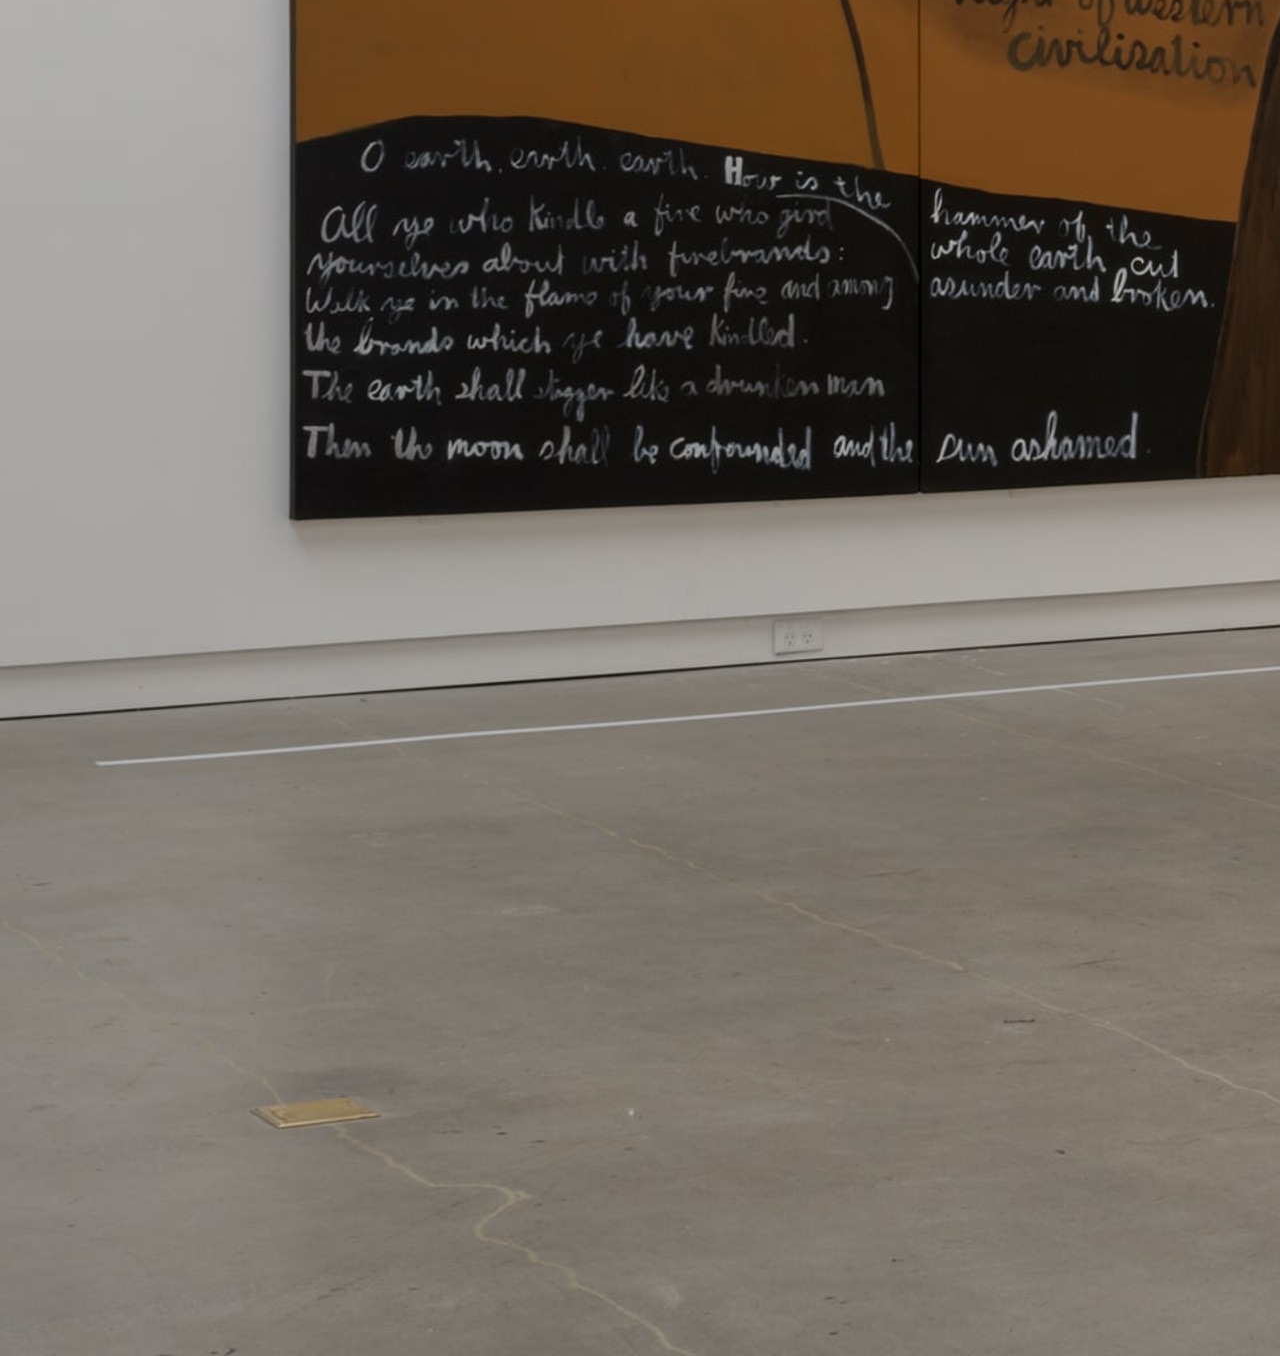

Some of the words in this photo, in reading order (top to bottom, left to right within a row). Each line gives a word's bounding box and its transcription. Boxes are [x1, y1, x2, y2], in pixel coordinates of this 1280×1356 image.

[360, 141, 384, 173] O
[795, 171, 818, 190] is
[835, 176, 891, 208] the
[392, 215, 434, 248] ye
[449, 197, 513, 234] who
[623, 210, 638, 227] a
[654, 193, 701, 235] fire
[716, 202, 769, 225] who
[930, 187, 1045, 231] hammer
[1058, 210, 1086, 243] of
[1106, 214, 1162, 250] the
[306, 251, 470, 285] yourselves
[482, 242, 563, 275] about
[582, 240, 647, 273] with
[930, 230, 1008, 265] whole
[1029, 236, 1106, 273] earth
[1130, 250, 1179, 278] cut
[379, 292, 416, 323] ye
[428, 290, 459, 310] in
[471, 286, 509, 311] the
[524, 279, 598, 318] flame
[608, 287, 632, 316] of
[641, 284, 713, 314] your
[724, 272, 767, 313] fire
[781, 274, 820, 301] and
[831, 275, 893, 310] among
[930, 270, 1041, 300] asunder
[1054, 276, 1099, 302] and
[303, 322, 341, 353] the
[354, 317, 453, 357] brands
[467, 323, 551, 354] which
[563, 330, 604, 362] ye
[618, 317, 694, 352] have
[303, 370, 352, 404] The
[367, 370, 442, 406] earth
[455, 367, 526, 401] shall
[623, 365, 670, 403] like
[682, 379, 699, 396] a
[707, 363, 820, 398] drunken
[827, 373, 885, 397] man
[303, 423, 372, 459] Then
[390, 425, 433, 461] the
[447, 438, 524, 461] moon
[539, 425, 609, 467] shall
[634, 425, 656, 464] be
[833, 425, 875, 467] and
[879, 422, 913, 463] the
